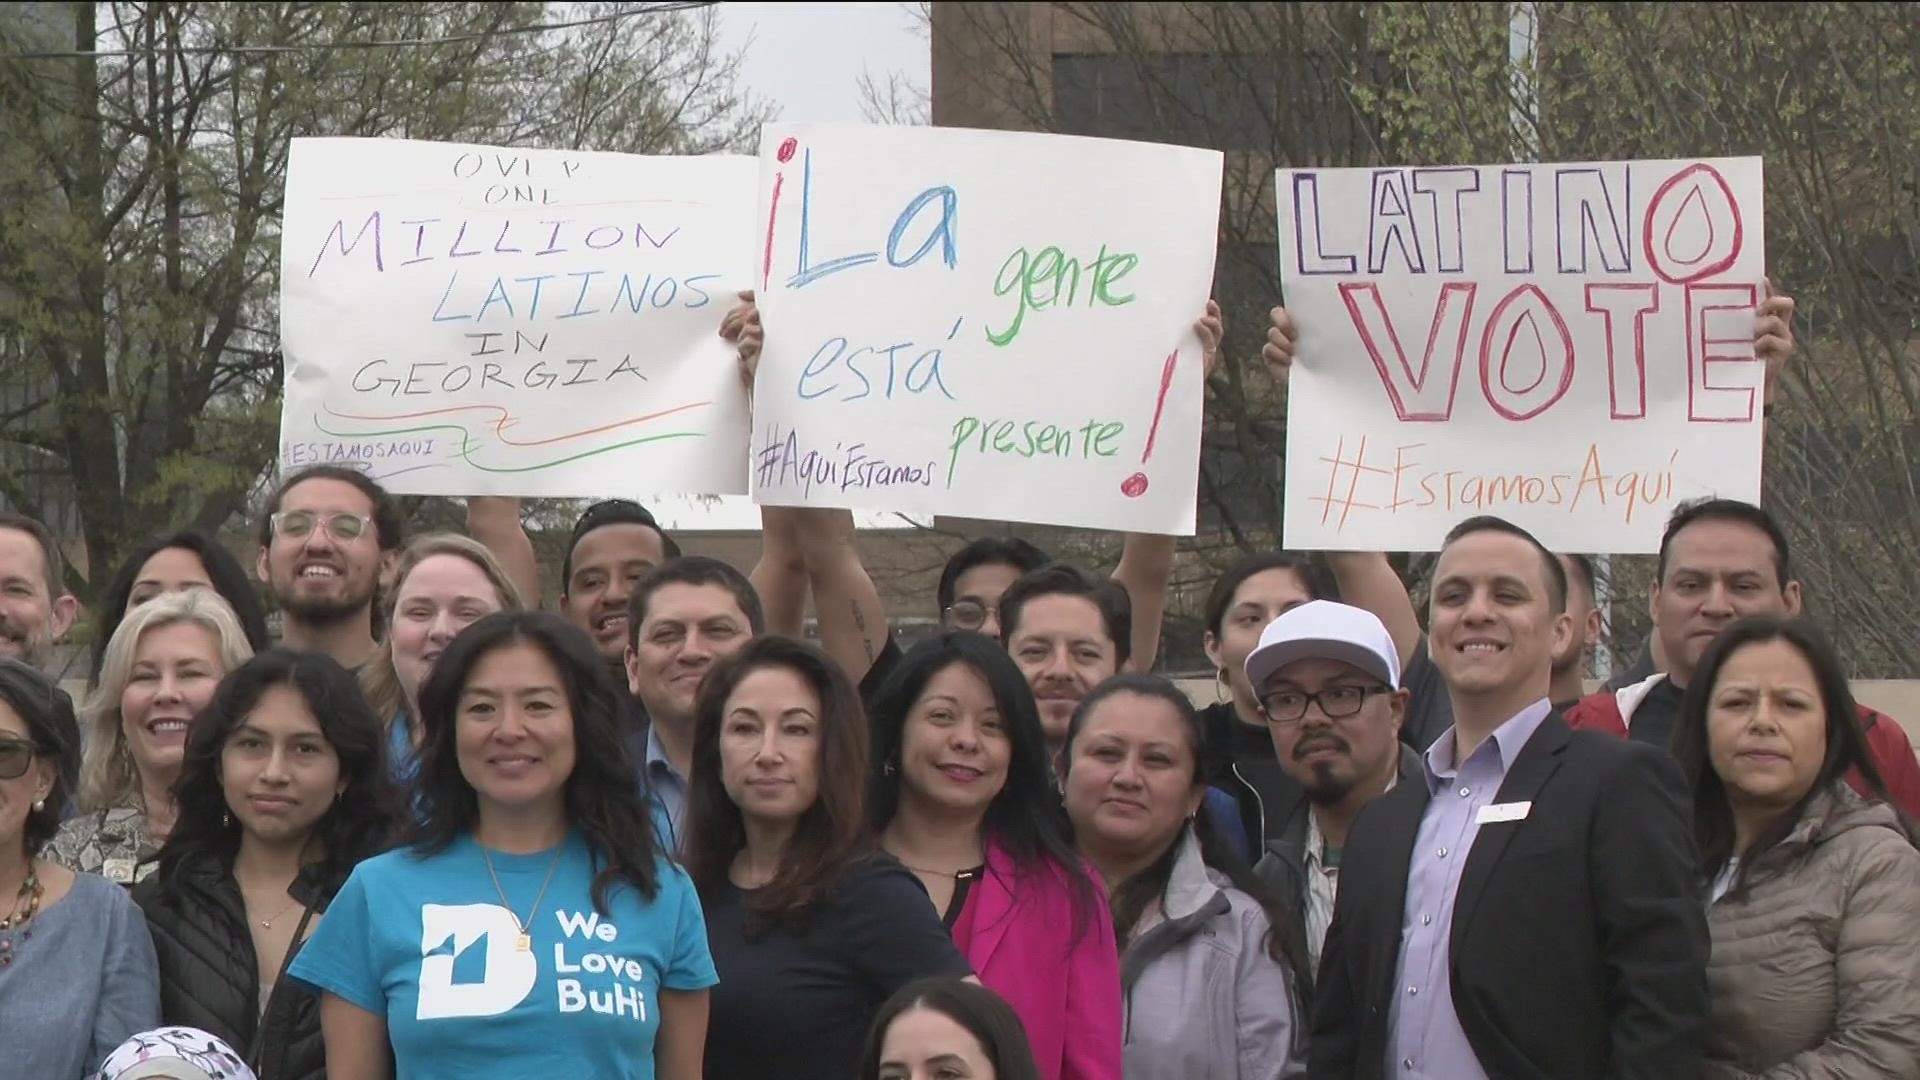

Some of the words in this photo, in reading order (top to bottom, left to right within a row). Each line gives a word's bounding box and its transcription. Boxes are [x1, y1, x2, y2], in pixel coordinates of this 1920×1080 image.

[308, 211, 681, 278] MILLION
[1291, 162, 1744, 285] LATINO
[432, 270, 723, 322] LATINOS
[985, 244, 1139, 347] gente
[464, 332, 549, 357] IN
[1338, 281, 1759, 423] VOTE
[352, 354, 648, 397] GEORGIA
[554, 909, 618, 943] We
[554, 943, 643, 982] Love
[556, 979, 647, 1023] BuHi
